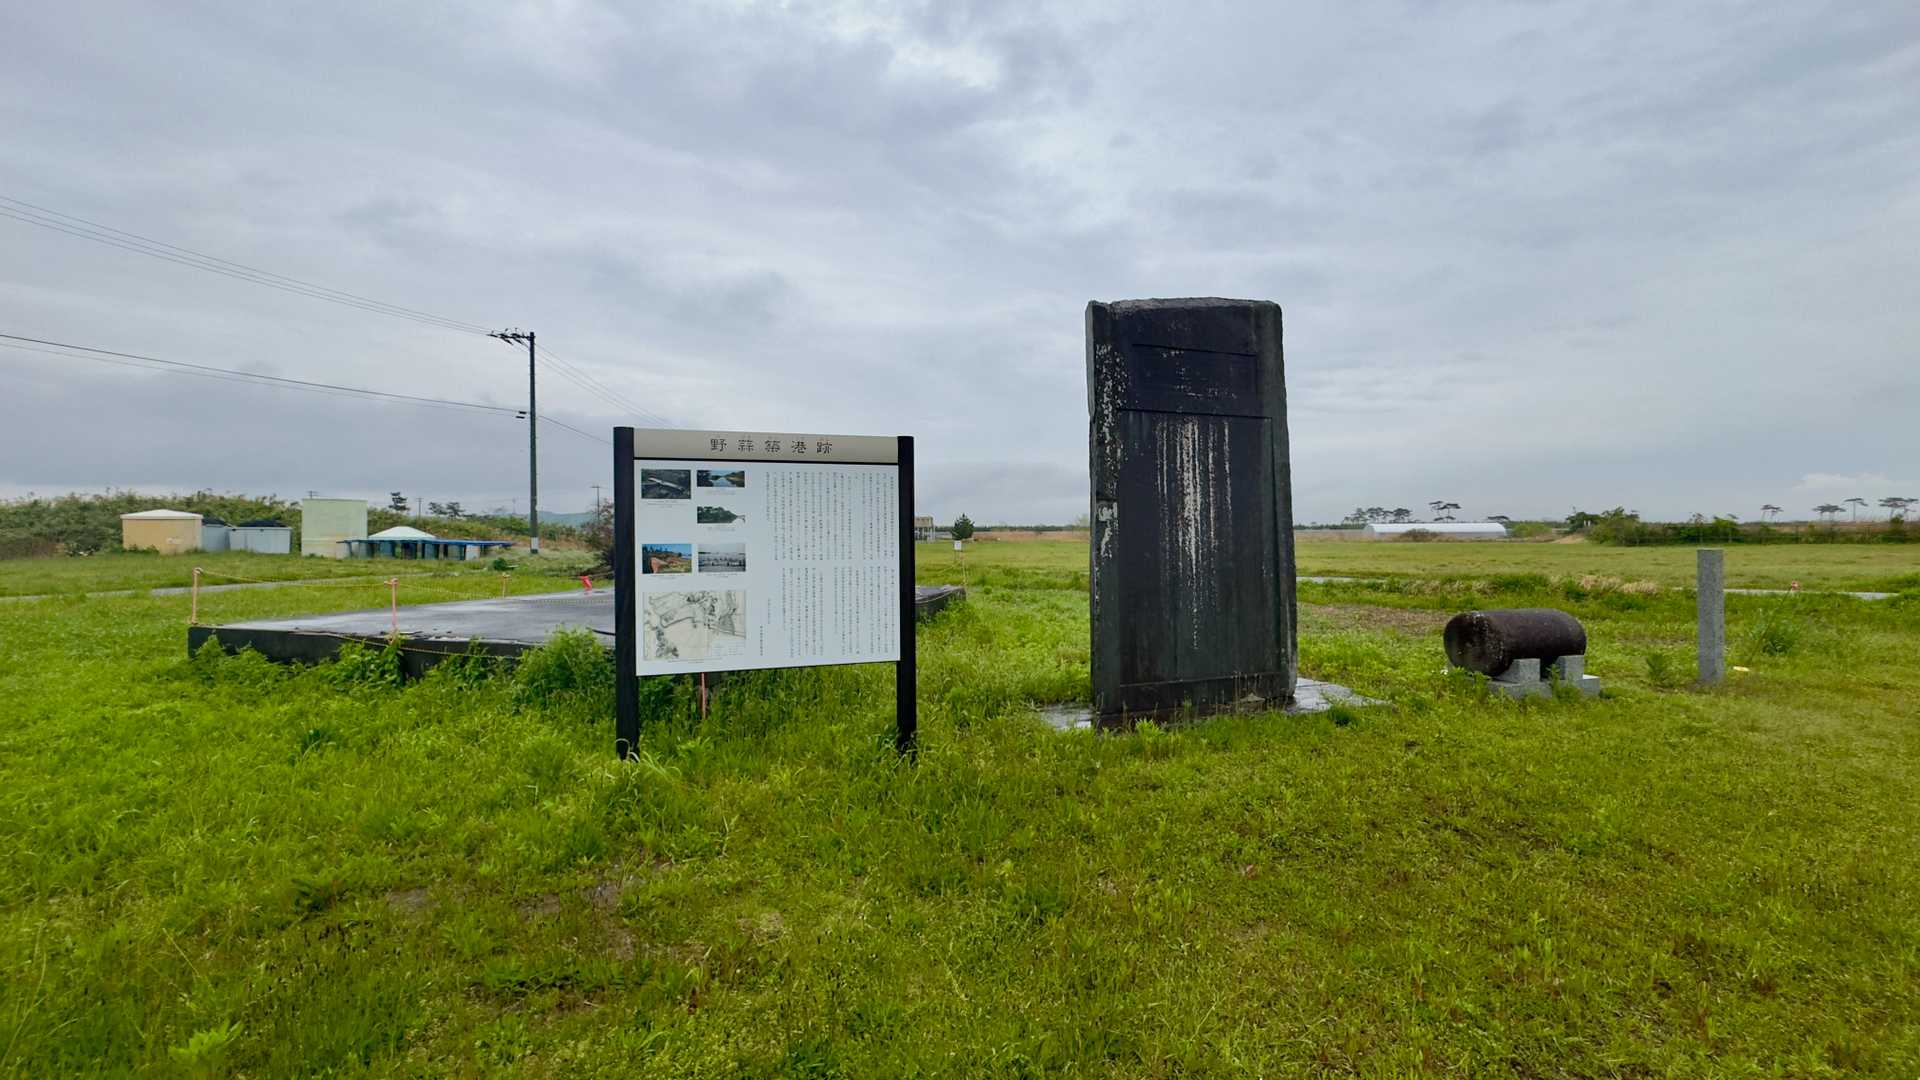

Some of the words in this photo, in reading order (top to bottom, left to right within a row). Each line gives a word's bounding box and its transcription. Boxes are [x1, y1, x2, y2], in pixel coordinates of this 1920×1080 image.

[710, 438, 833, 454] 野蒜築港跡
